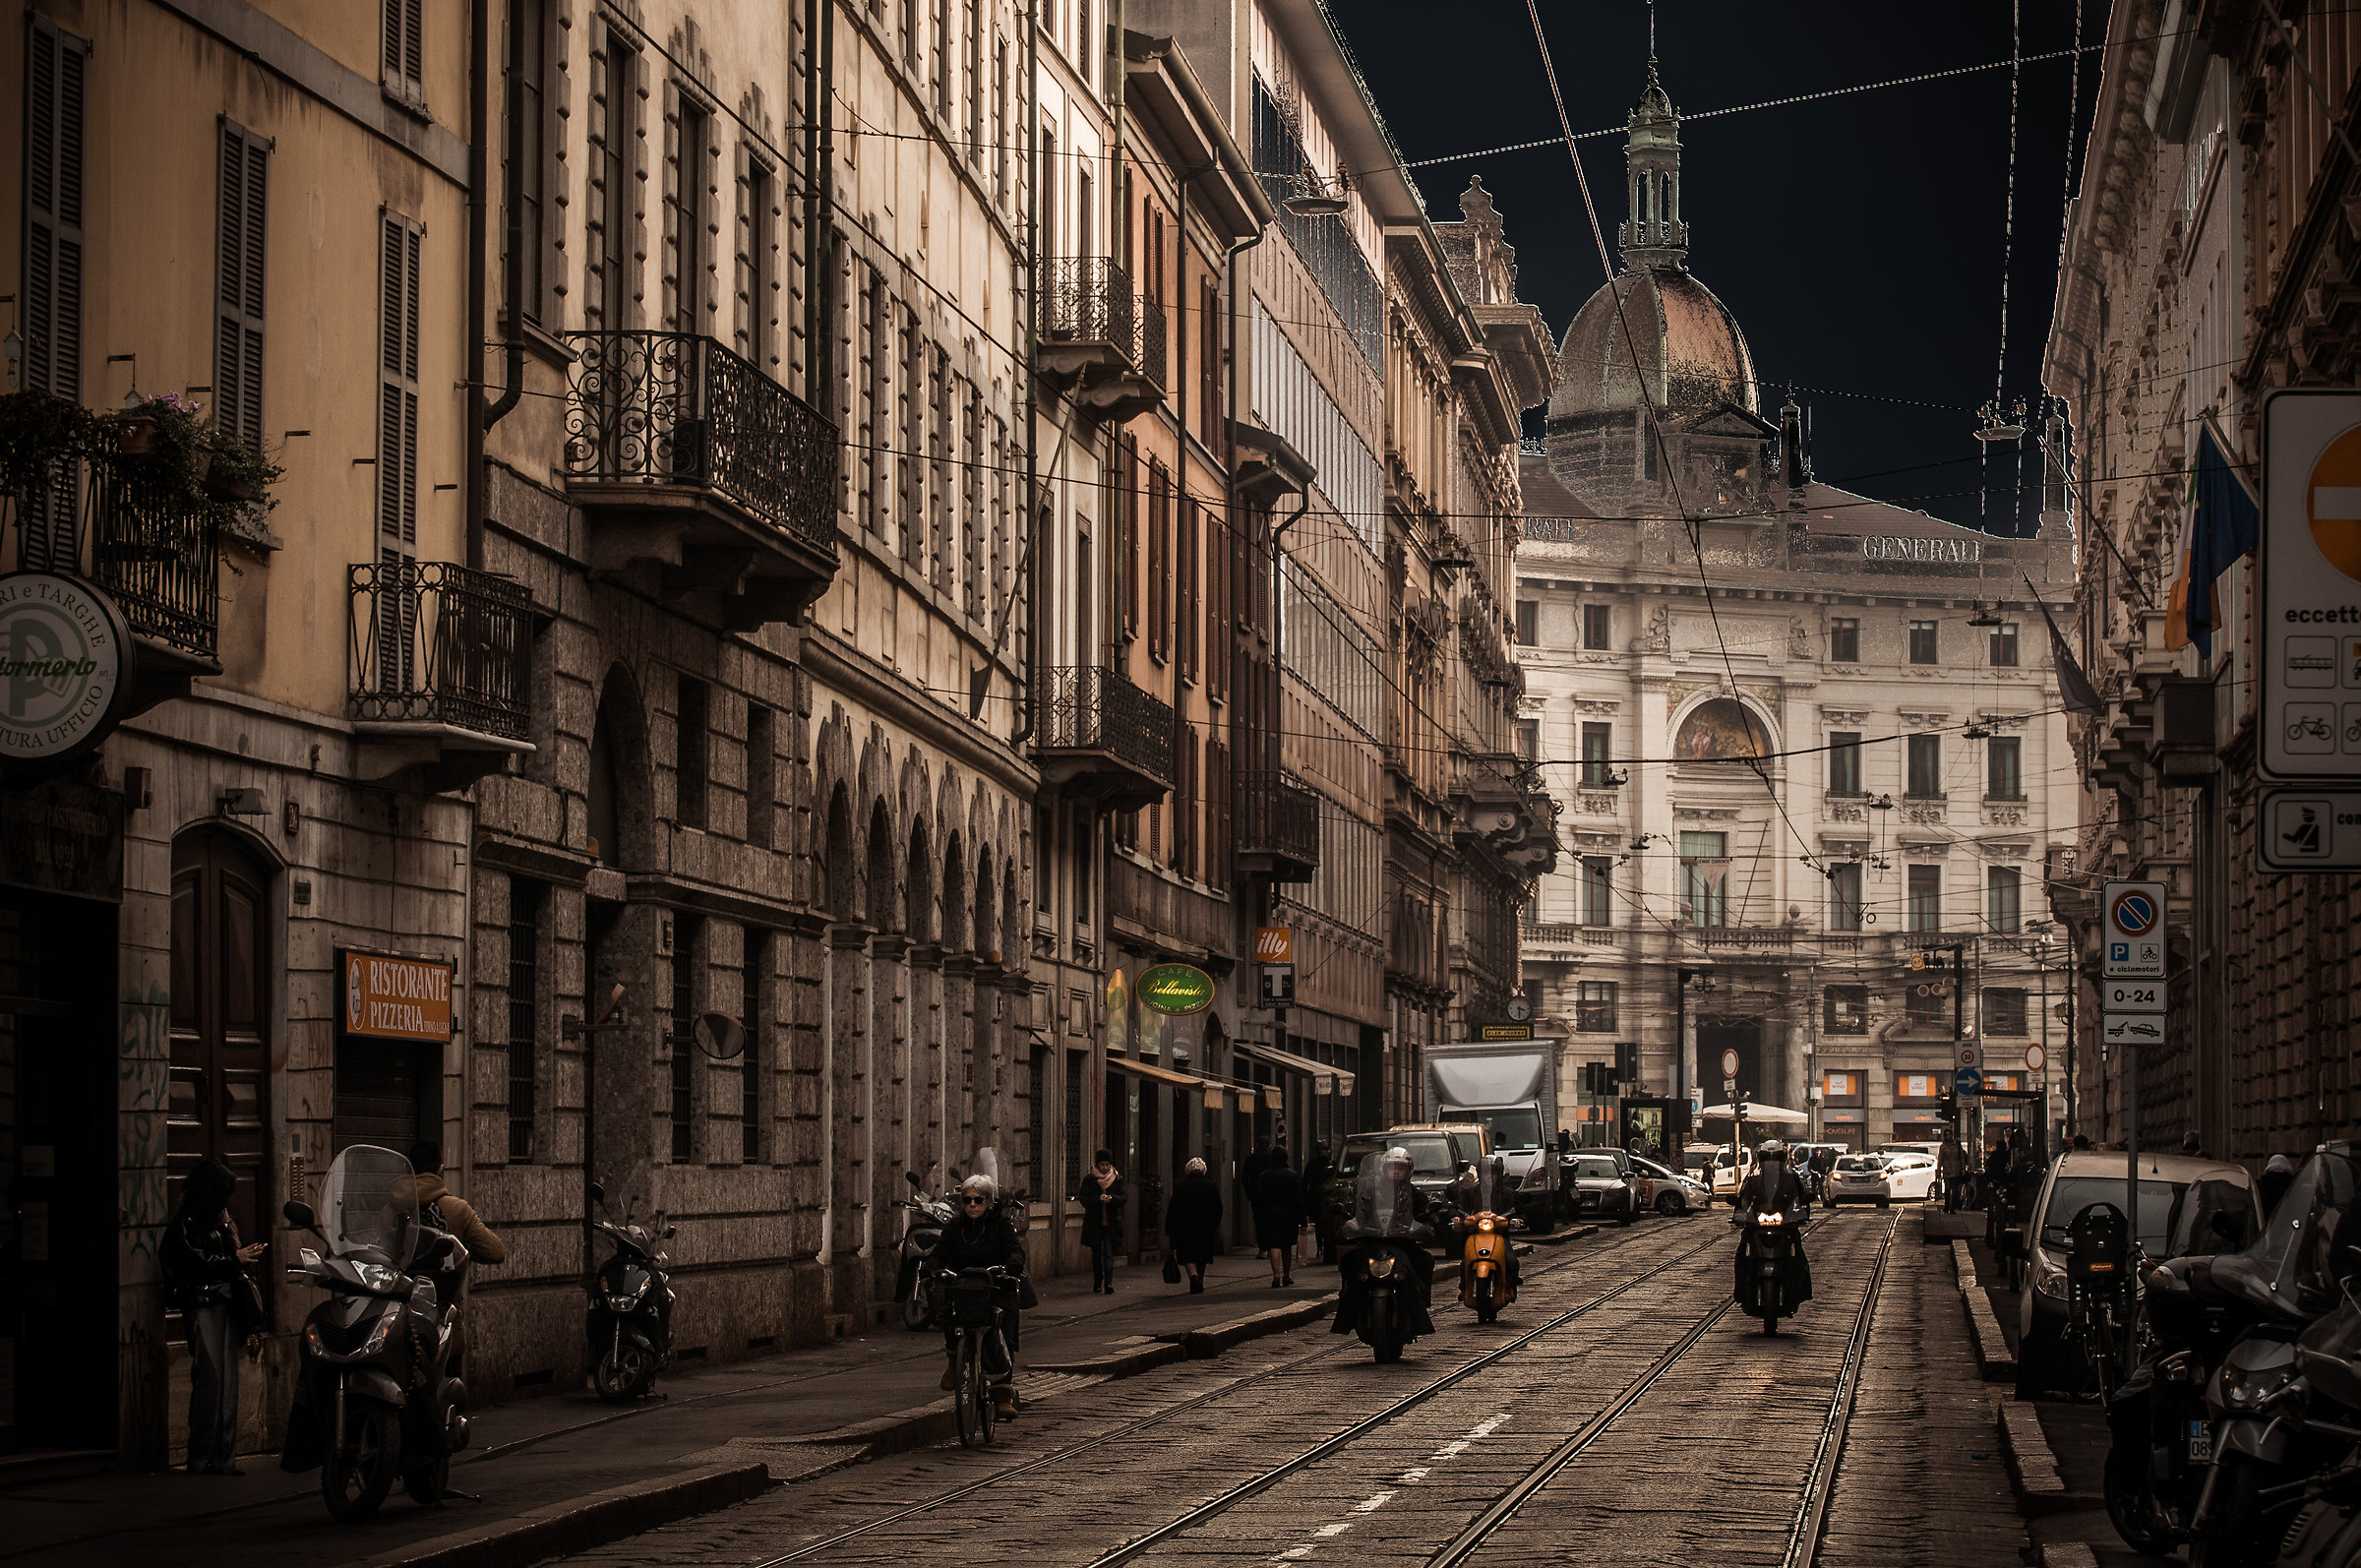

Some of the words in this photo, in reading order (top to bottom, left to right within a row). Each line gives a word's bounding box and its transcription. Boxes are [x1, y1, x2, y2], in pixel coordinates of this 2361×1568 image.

[1522, 517, 1574, 541] RALI
[1863, 535, 1982, 563] GENERALI
[38, 583, 106, 647] TARGHE
[2285, 606, 2361, 623] eccett
[46, 685, 103, 745] UFFICIO
[1257, 932, 1288, 959] illy
[2115, 945, 2125, 959] P
[370, 960, 449, 1002] RISTORANTE
[1146, 978, 1205, 996] Bellavista
[370, 1000, 424, 1032] PIZZERIA
